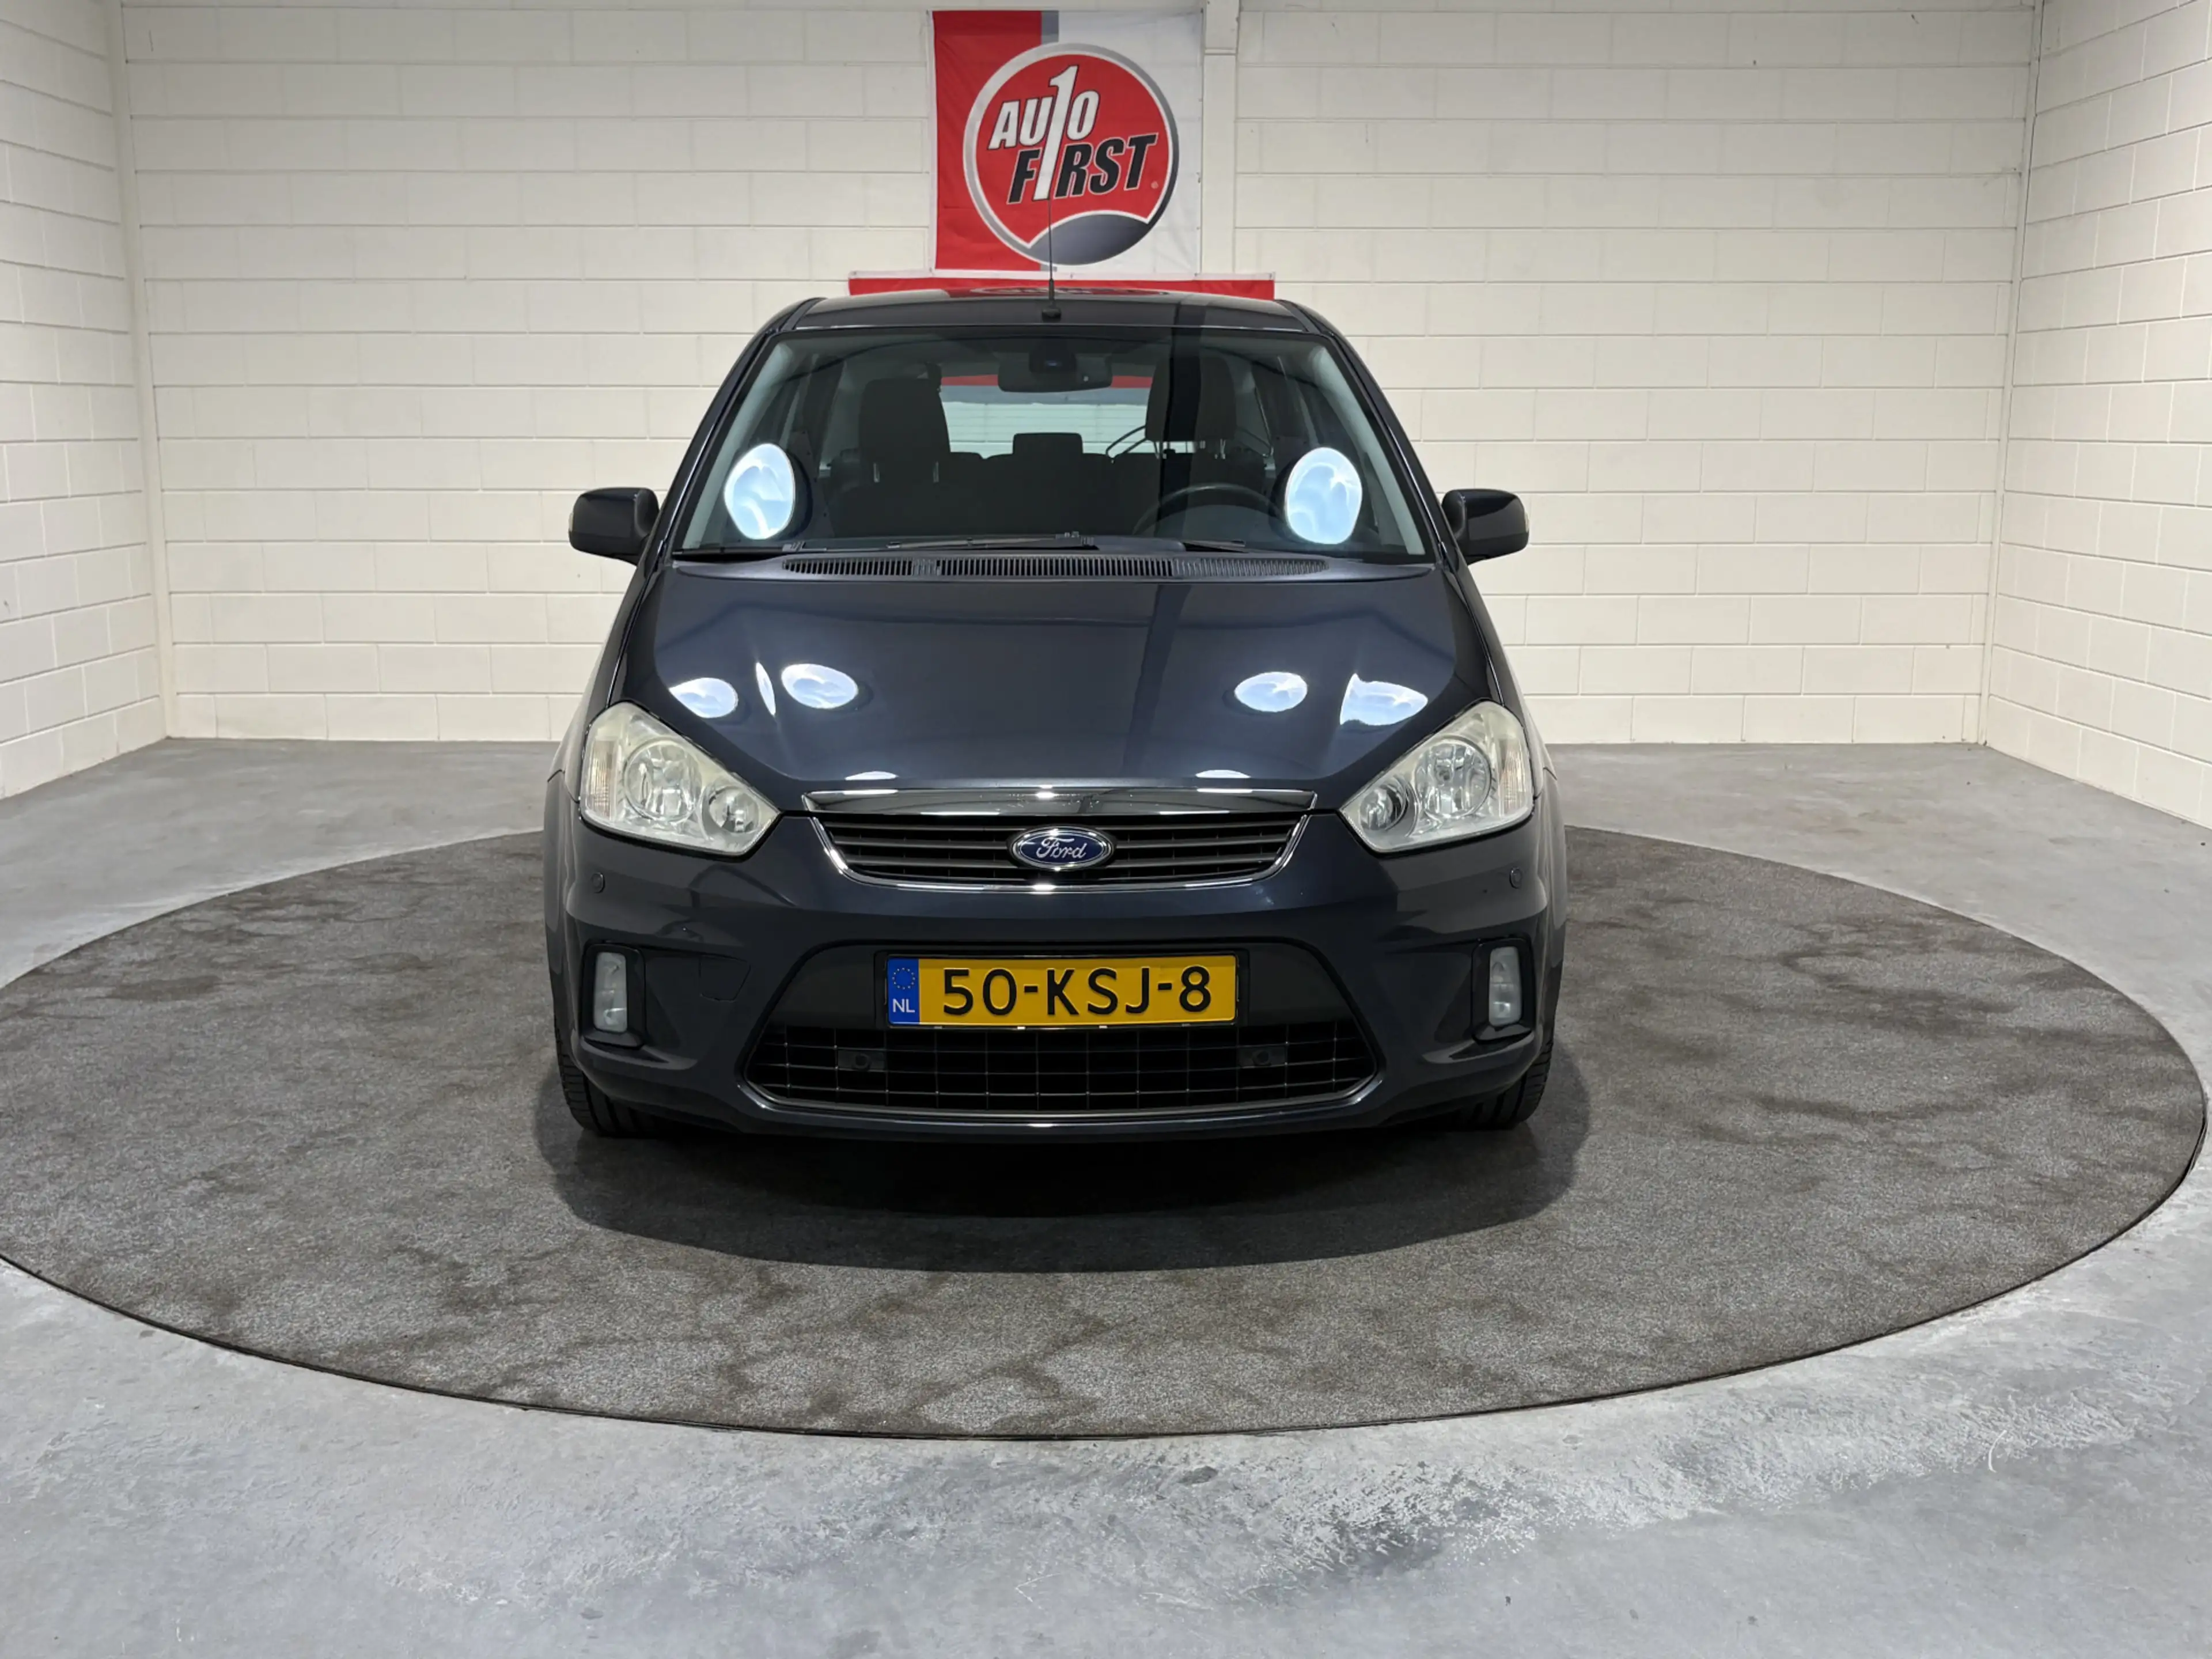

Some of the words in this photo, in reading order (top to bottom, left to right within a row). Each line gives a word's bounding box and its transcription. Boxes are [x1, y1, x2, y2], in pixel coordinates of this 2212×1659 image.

[1036, 836, 1088, 858] Ford
[942, 965, 1211, 1016] 50-KSJ-8
[892, 999, 915, 1013] NL
